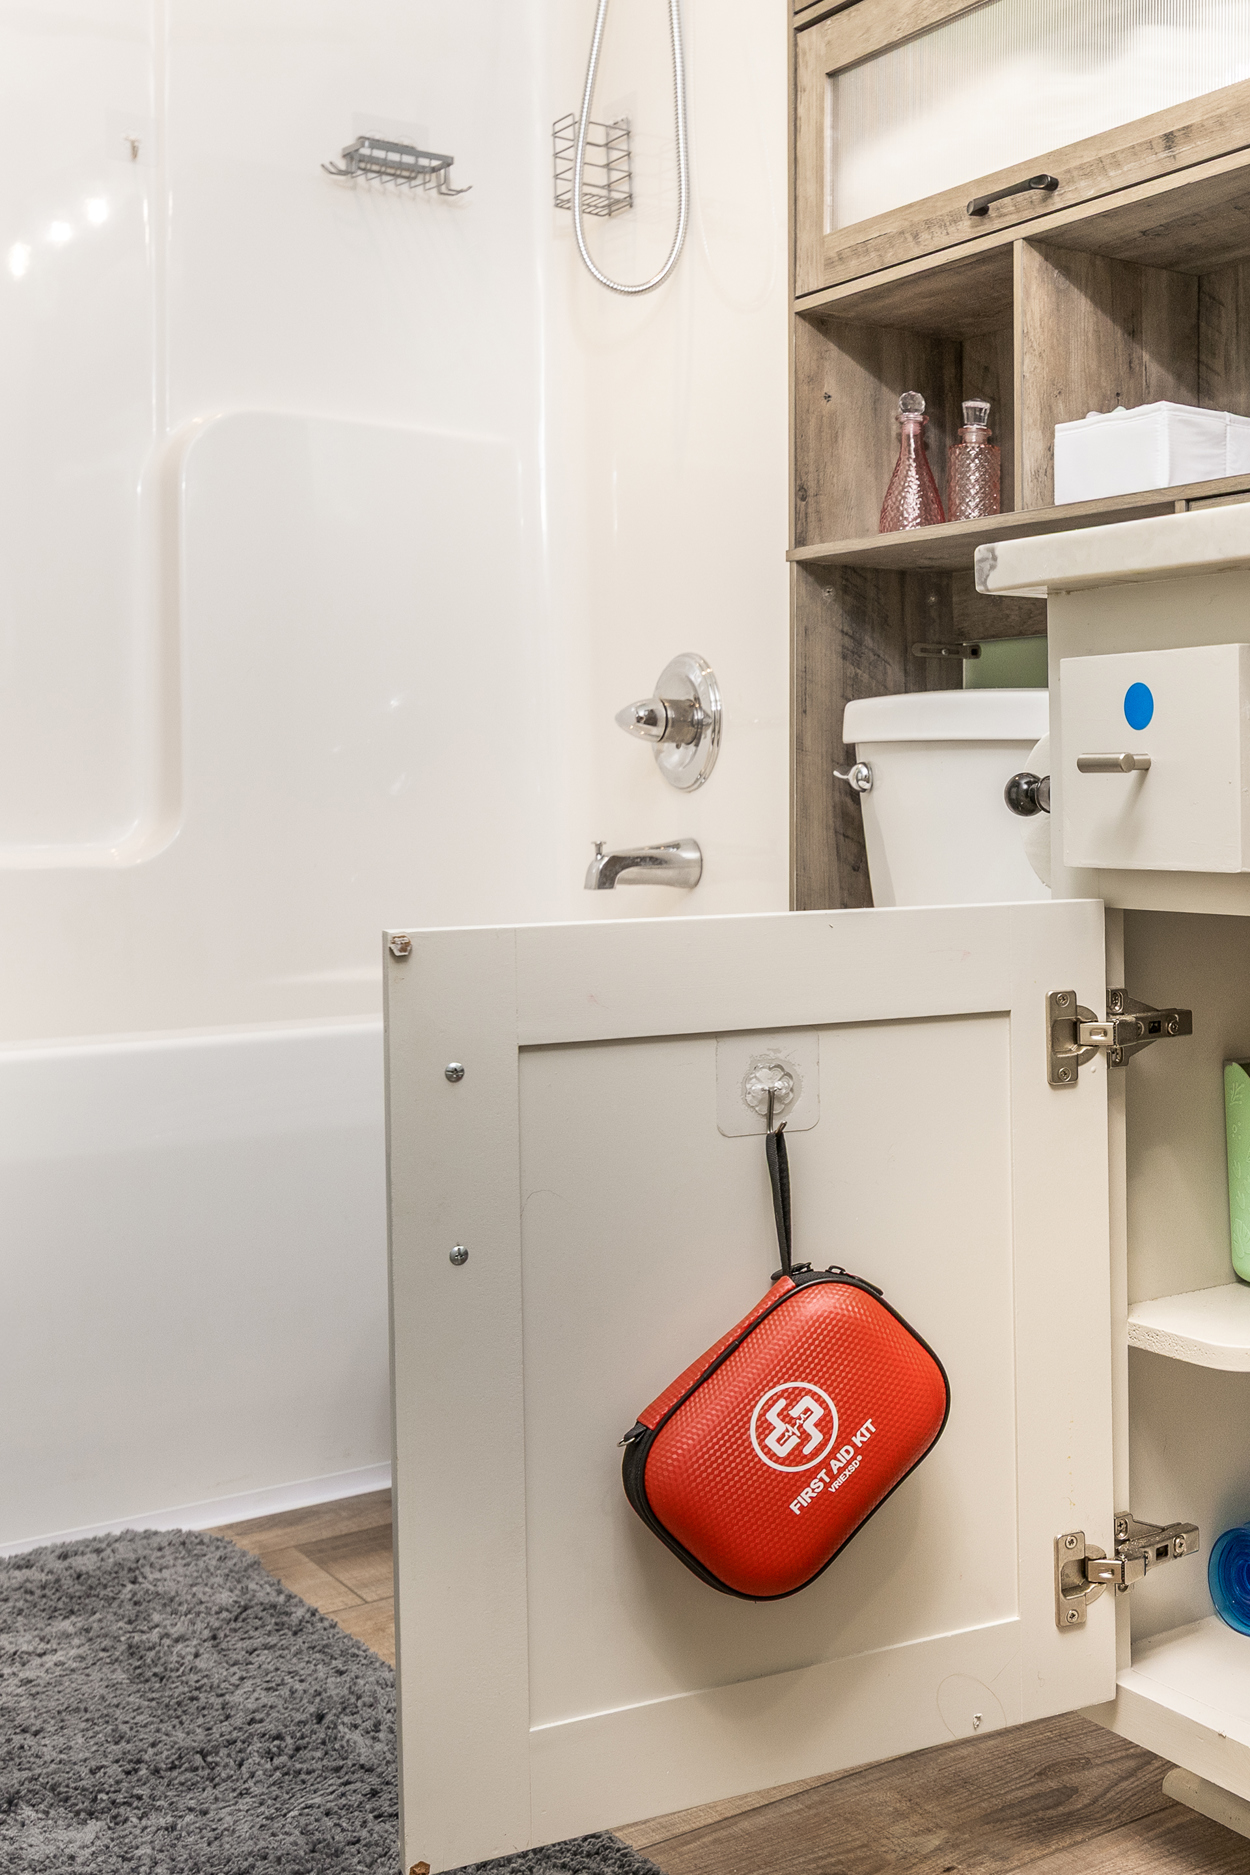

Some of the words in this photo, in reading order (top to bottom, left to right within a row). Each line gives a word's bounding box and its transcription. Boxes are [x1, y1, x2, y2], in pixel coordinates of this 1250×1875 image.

[789, 1468, 831, 1515] FIRST
[829, 1444, 855, 1475] AID
[851, 1418, 877, 1448] KIT
